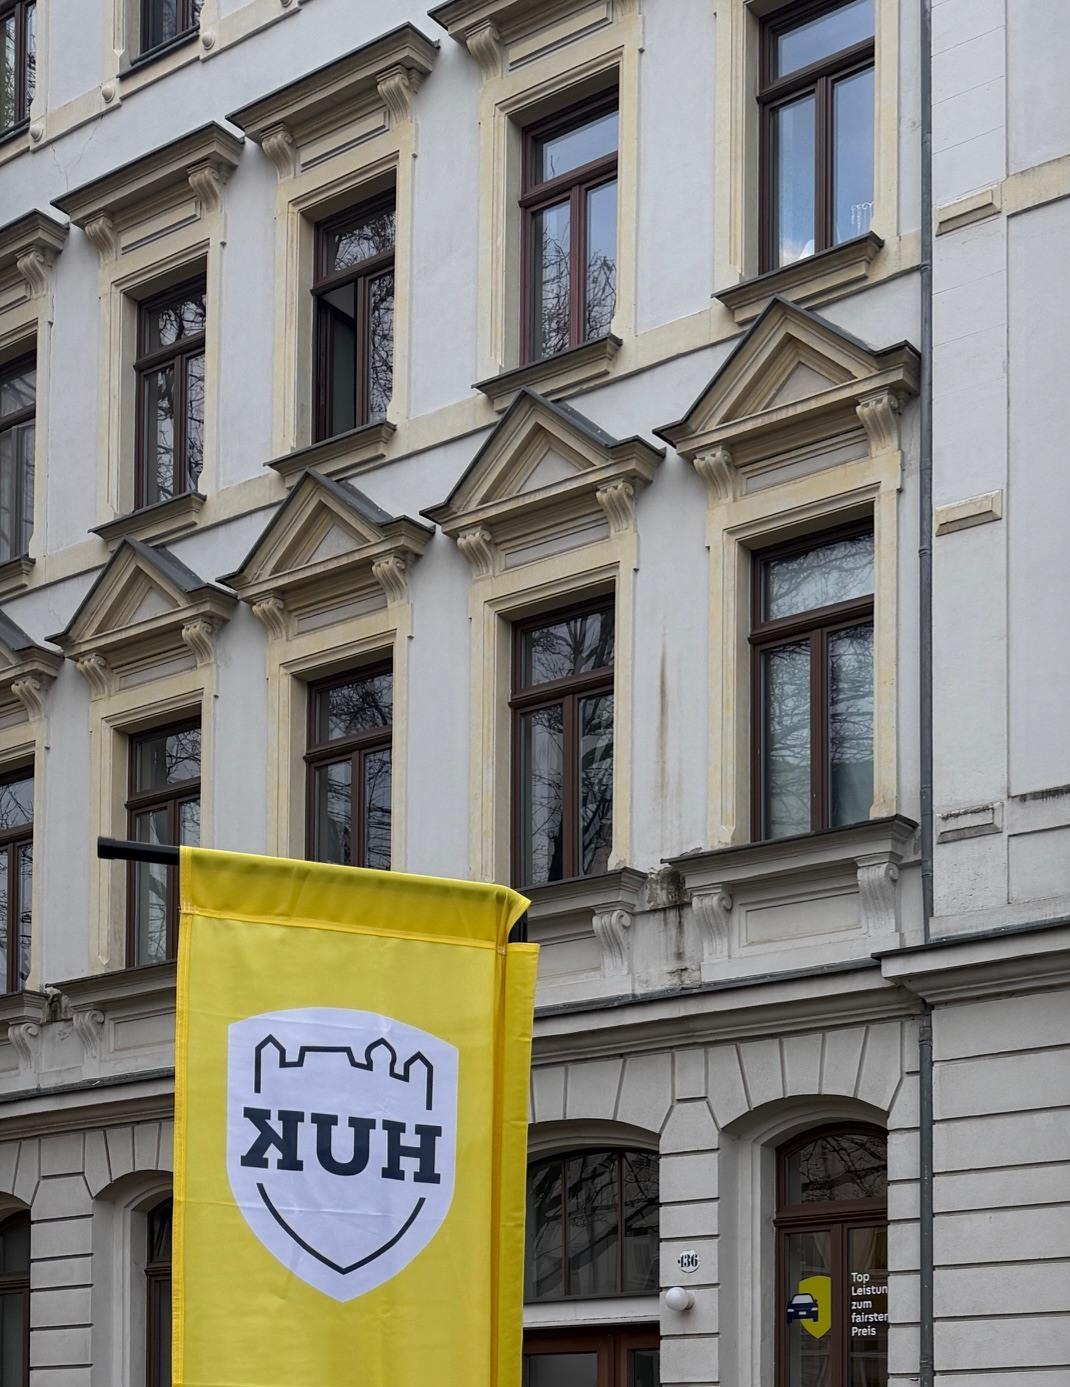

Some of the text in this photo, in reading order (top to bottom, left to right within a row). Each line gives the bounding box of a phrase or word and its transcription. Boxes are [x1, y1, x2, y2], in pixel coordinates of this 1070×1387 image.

[680, 1253, 698, 1268] 136
[850, 1272, 870, 1284] Top
[851, 1284, 888, 1296] Leistun
[851, 1300, 873, 1310] zum
[851, 1325, 877, 1337] Preis
